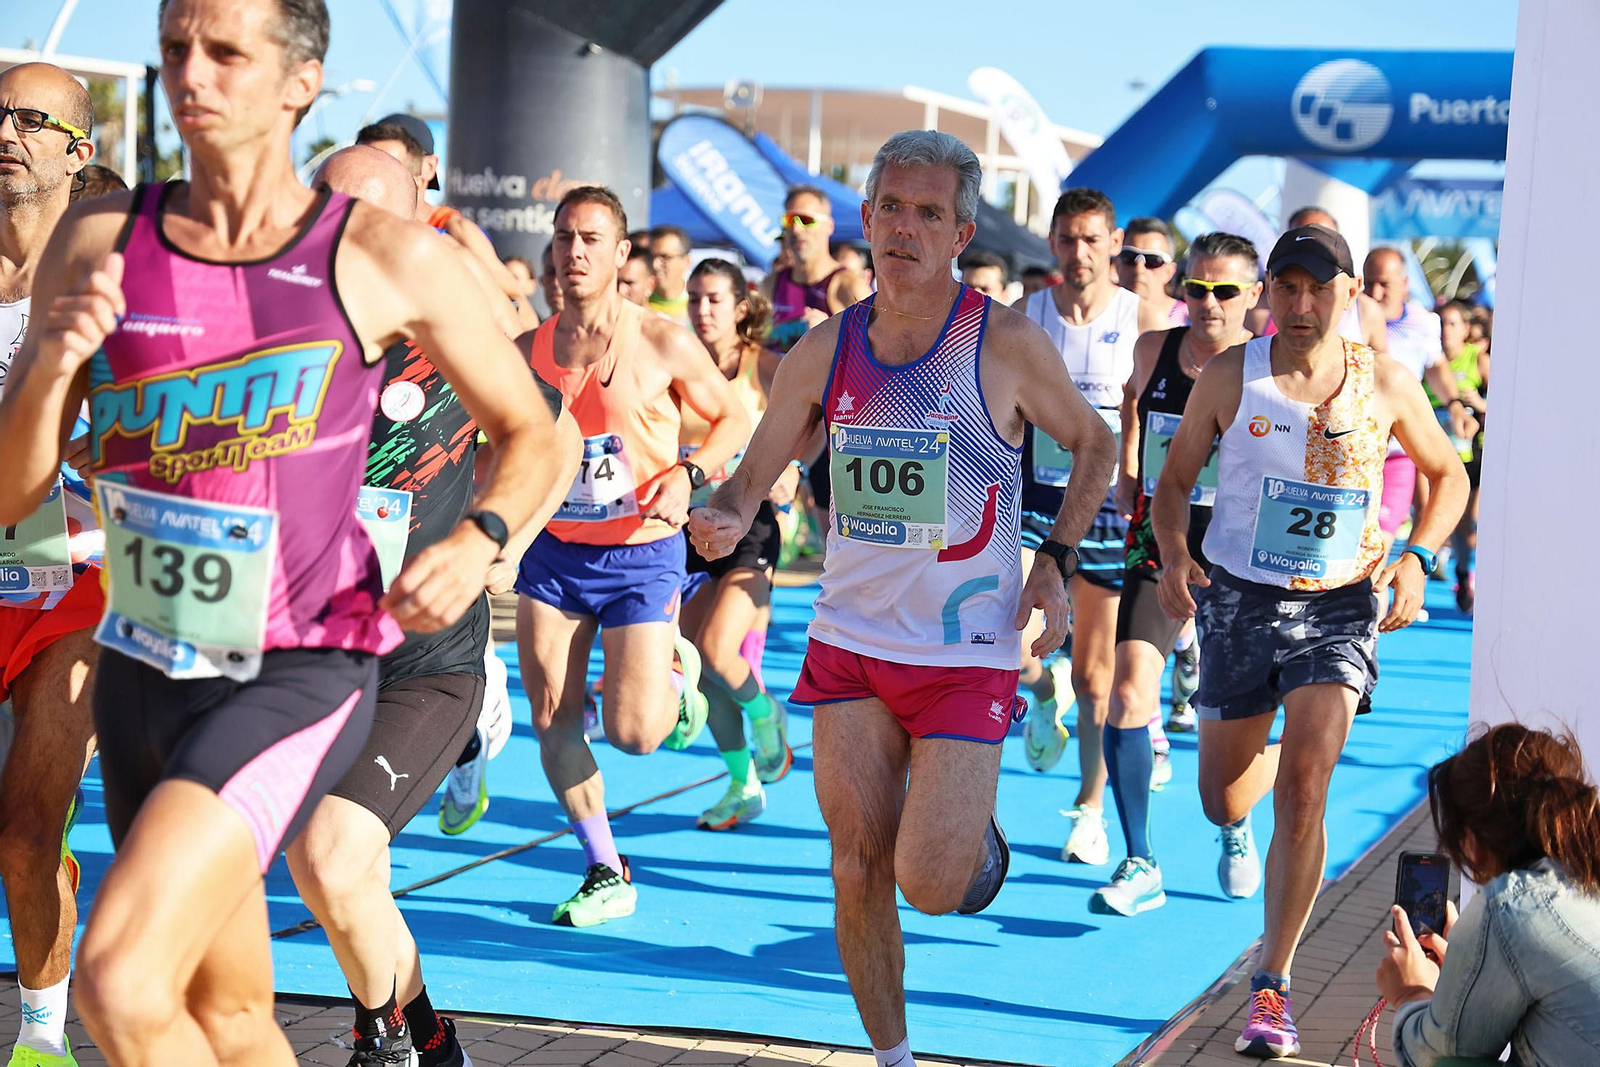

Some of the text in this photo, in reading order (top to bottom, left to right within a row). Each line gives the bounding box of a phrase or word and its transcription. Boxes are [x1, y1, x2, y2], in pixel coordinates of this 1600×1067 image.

[1274, 424, 1291, 433] NN
[875, 436, 914, 449] AVATEL
[845, 457, 925, 497] 106
[1310, 490, 1344, 504] AVATEL
[856, 511, 911, 521] HERNANDEZ HERRERO
[874, 505, 905, 513] FRANCISCO
[159, 508, 223, 540] AVATEL
[849, 517, 898, 536] Wayalia
[1286, 507, 1338, 540] 28
[123, 535, 233, 604] 139
[1269, 553, 1322, 572] Wayalia
